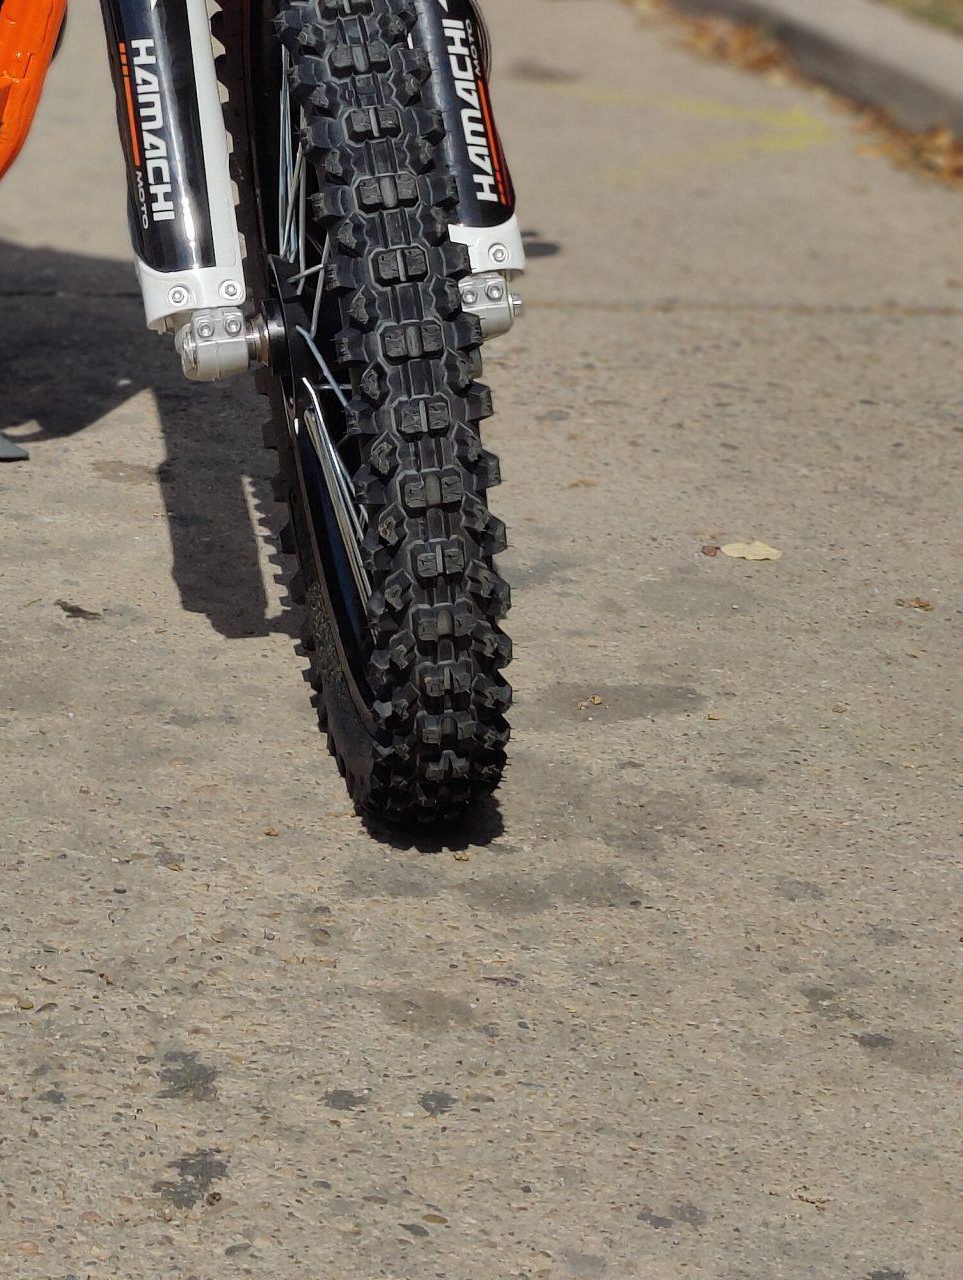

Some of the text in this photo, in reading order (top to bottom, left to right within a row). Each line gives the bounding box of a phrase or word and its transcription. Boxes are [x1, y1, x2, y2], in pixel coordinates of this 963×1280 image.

[465, 19, 481, 77] MOTO
[131, 38, 175, 222] HAMACHI
[442, 18, 499, 202] HAMACHI
[136, 170, 149, 230] MOTO
